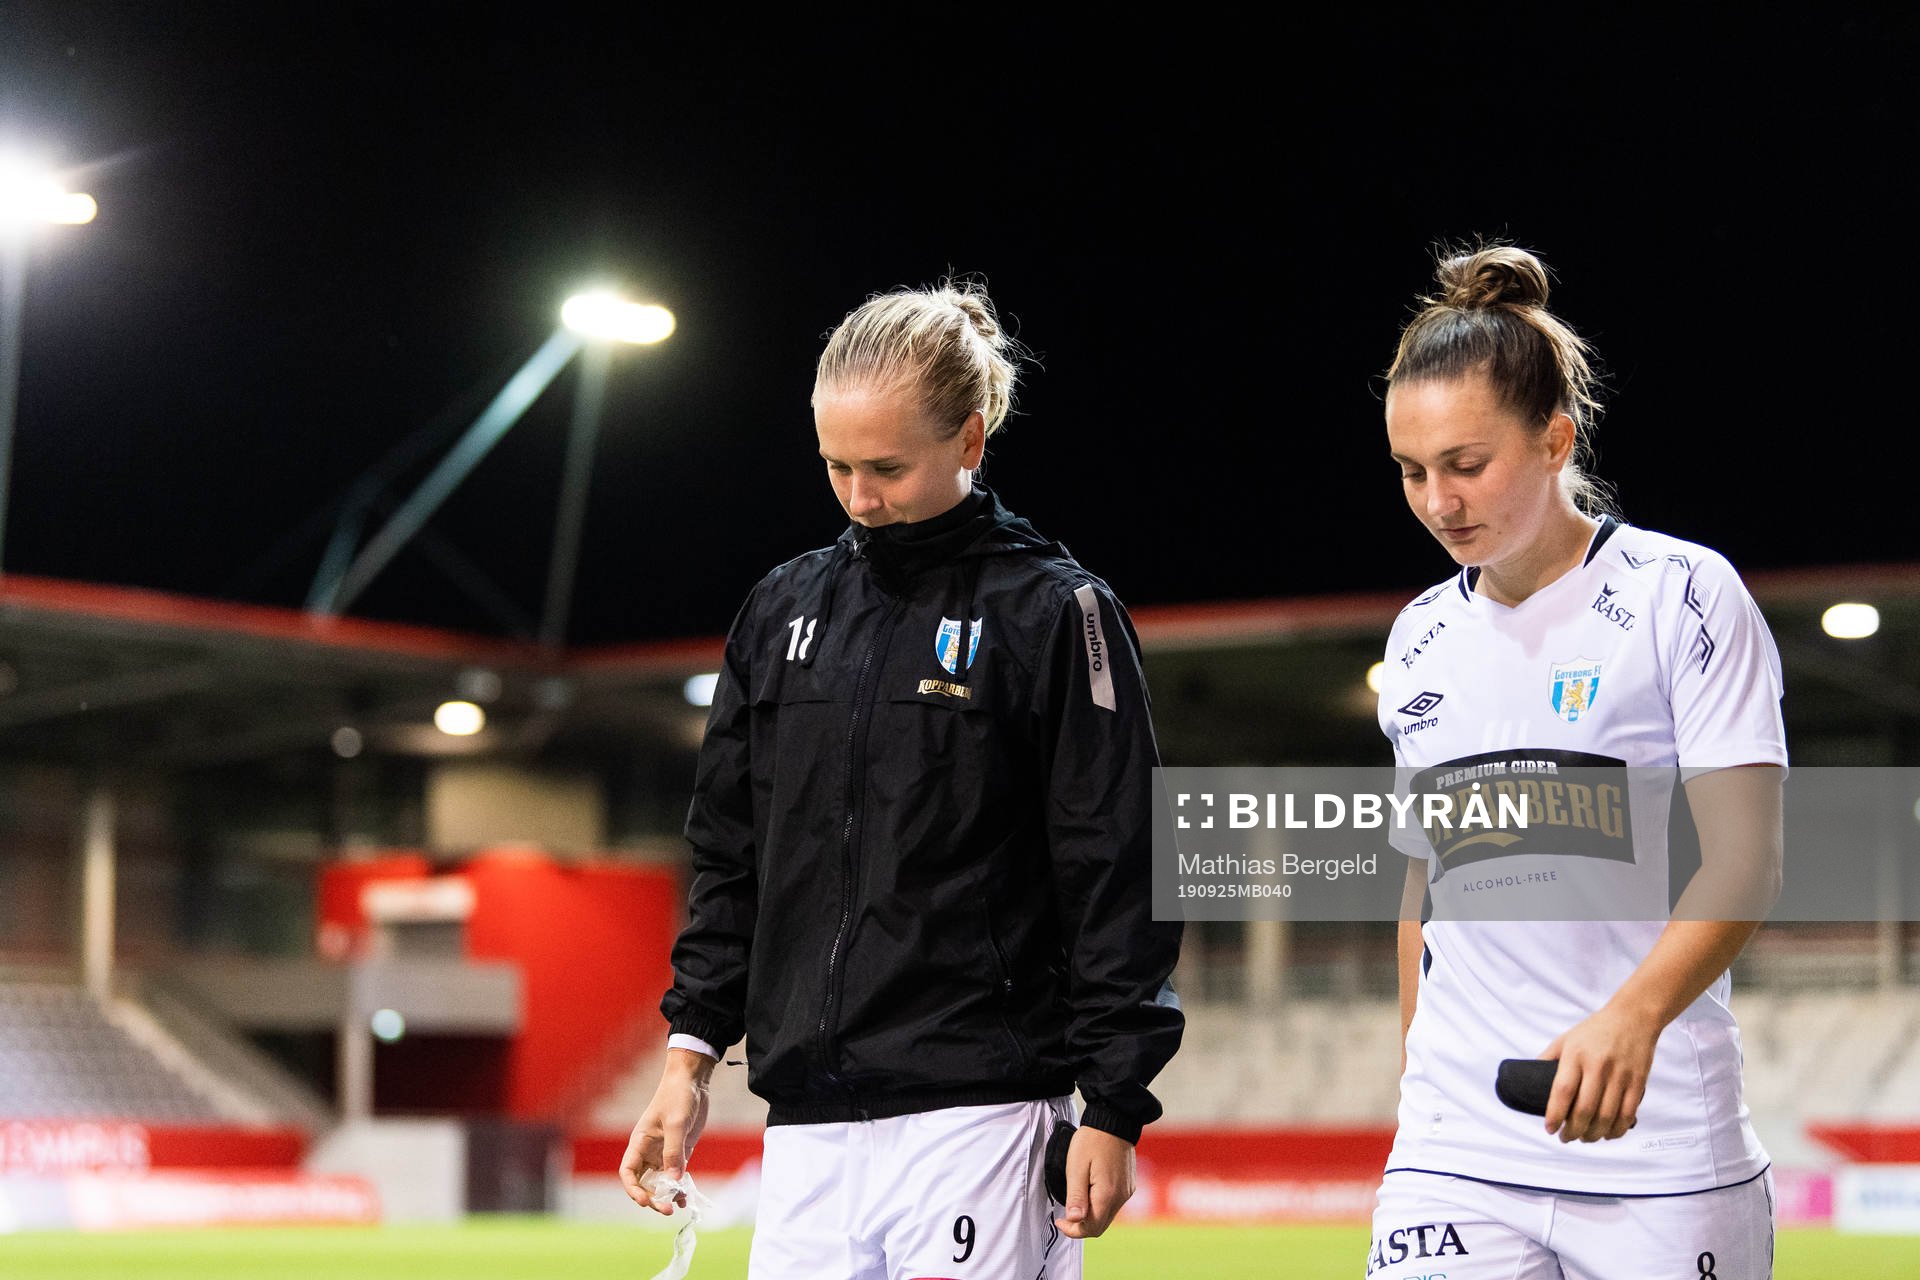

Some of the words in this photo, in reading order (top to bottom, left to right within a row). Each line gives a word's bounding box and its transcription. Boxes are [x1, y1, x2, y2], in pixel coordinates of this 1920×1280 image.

[1086, 613, 1103, 672] umbro
[1404, 717, 1439, 736] umbro
[1436, 762, 1507, 791] PREMIUM
[1510, 760, 1559, 775] CIDER
[1463, 870, 1558, 893] ALCOHOL-FREE
[953, 1215, 976, 1264] 9
